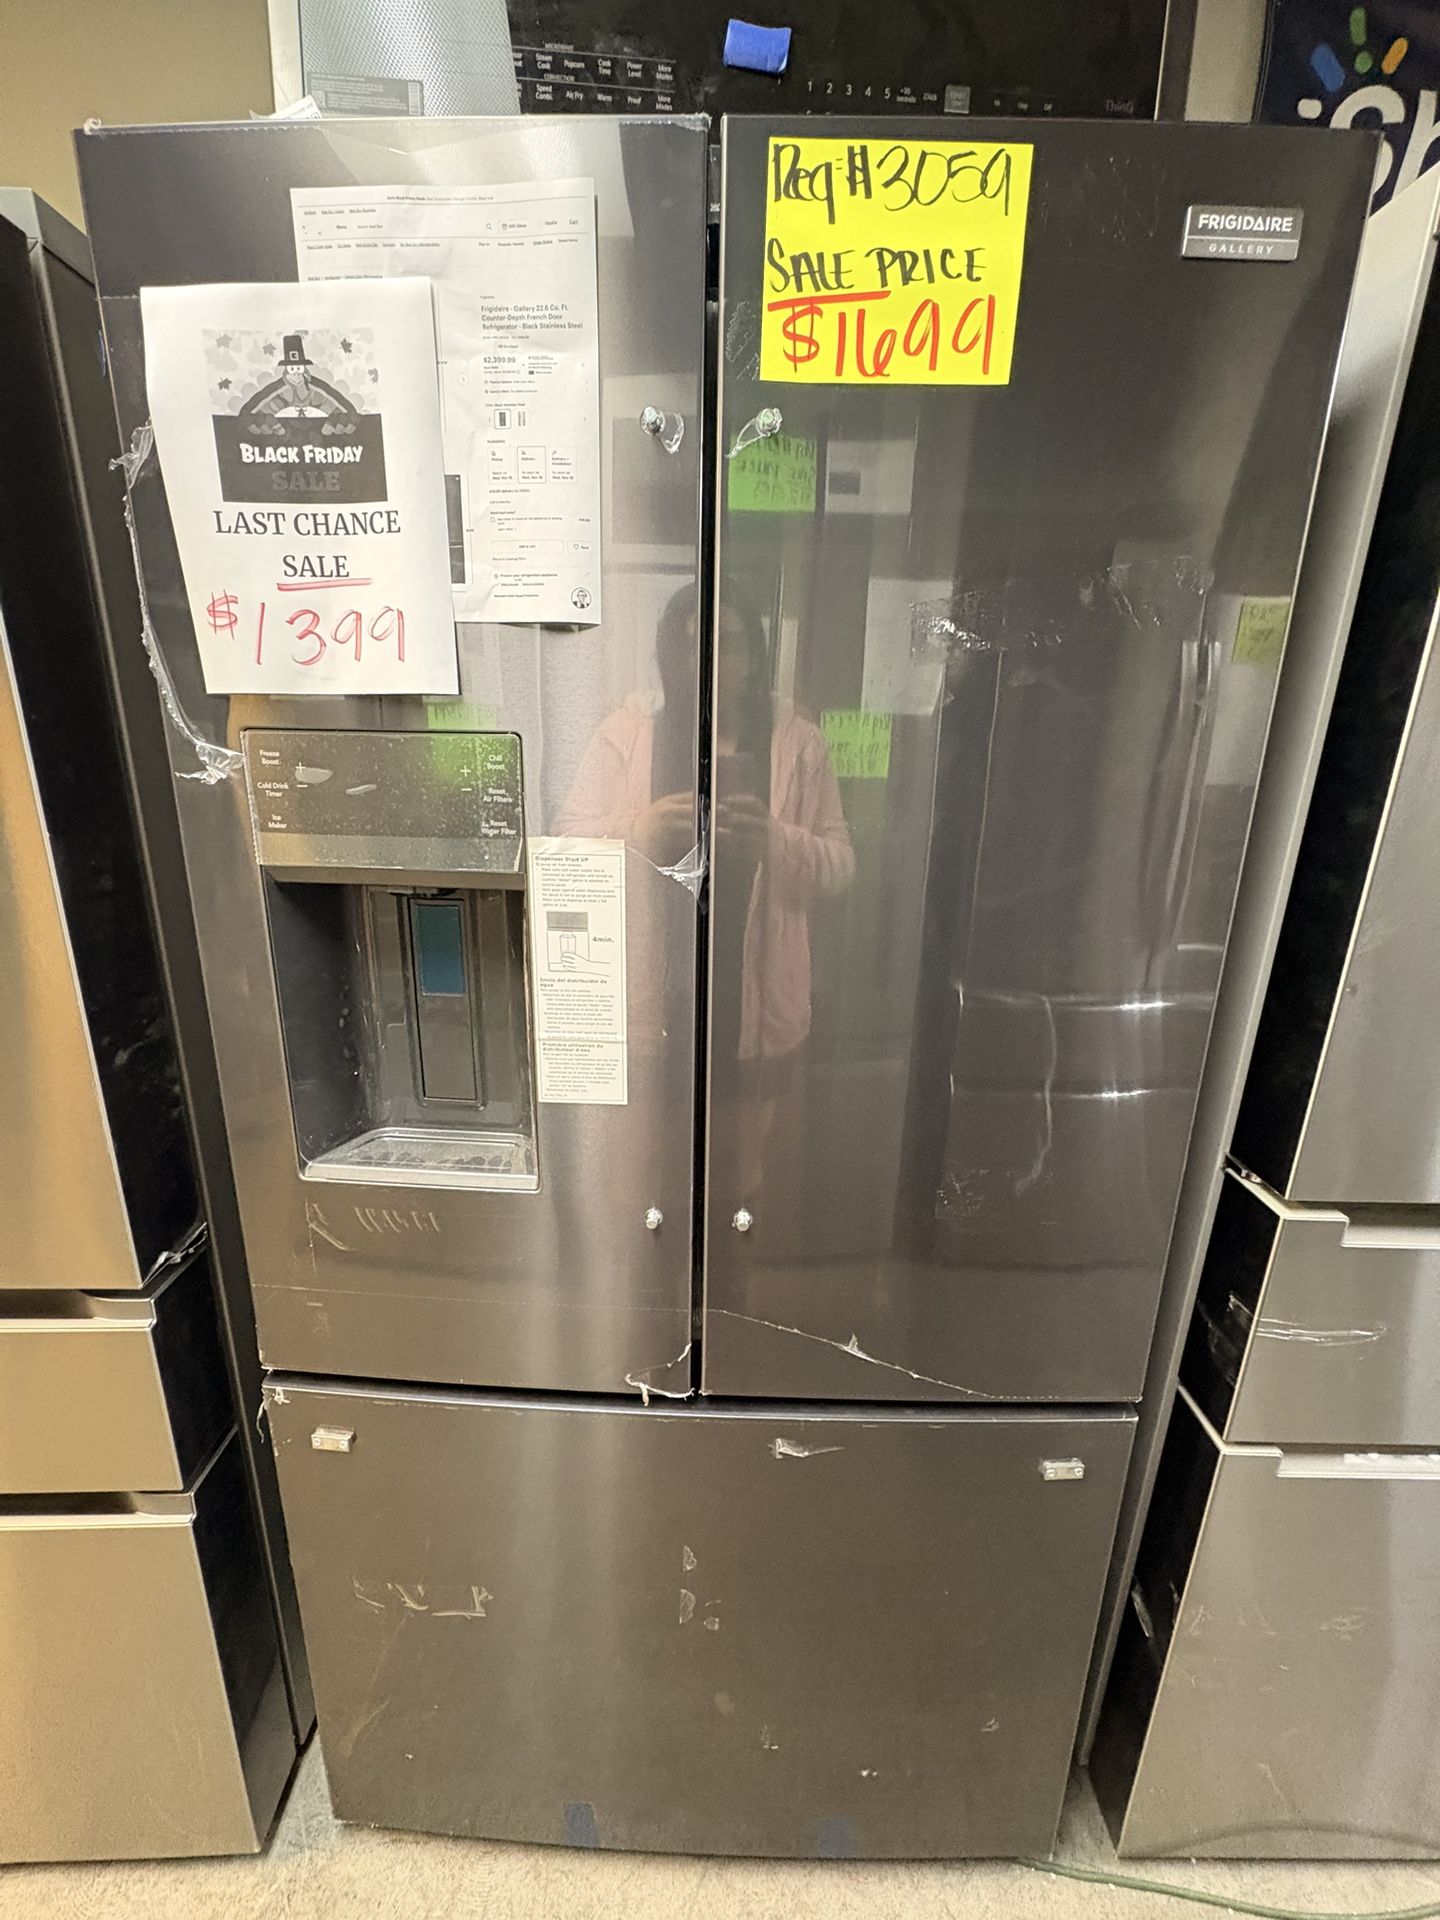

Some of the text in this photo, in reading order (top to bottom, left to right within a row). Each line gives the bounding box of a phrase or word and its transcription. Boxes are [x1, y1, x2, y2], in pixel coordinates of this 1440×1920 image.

[564, 60, 585, 69] Popcorn
[627, 62, 642, 70] Power
[808, 81, 890, 99] 1 2 3 4 5
[1198, 214, 1294, 232] FRIGIDAIRE
[1209, 243, 1274, 255] GALLERY
[767, 237, 986, 293] SALE PRICE
[481, 305, 509, 314] Frigidaire
[514, 304, 534, 313] Gallery
[482, 314, 526, 322] Counter-Depth
[482, 322, 518, 331] Refrigerator
[782, 294, 996, 378] $1699
[239, 443, 364, 464] BLACK FRIDAY
[272, 470, 340, 492] SALE
[213, 510, 401, 536] LAST CHANCE
[282, 554, 350, 578] SALE
[206, 589, 405, 666] $1399
